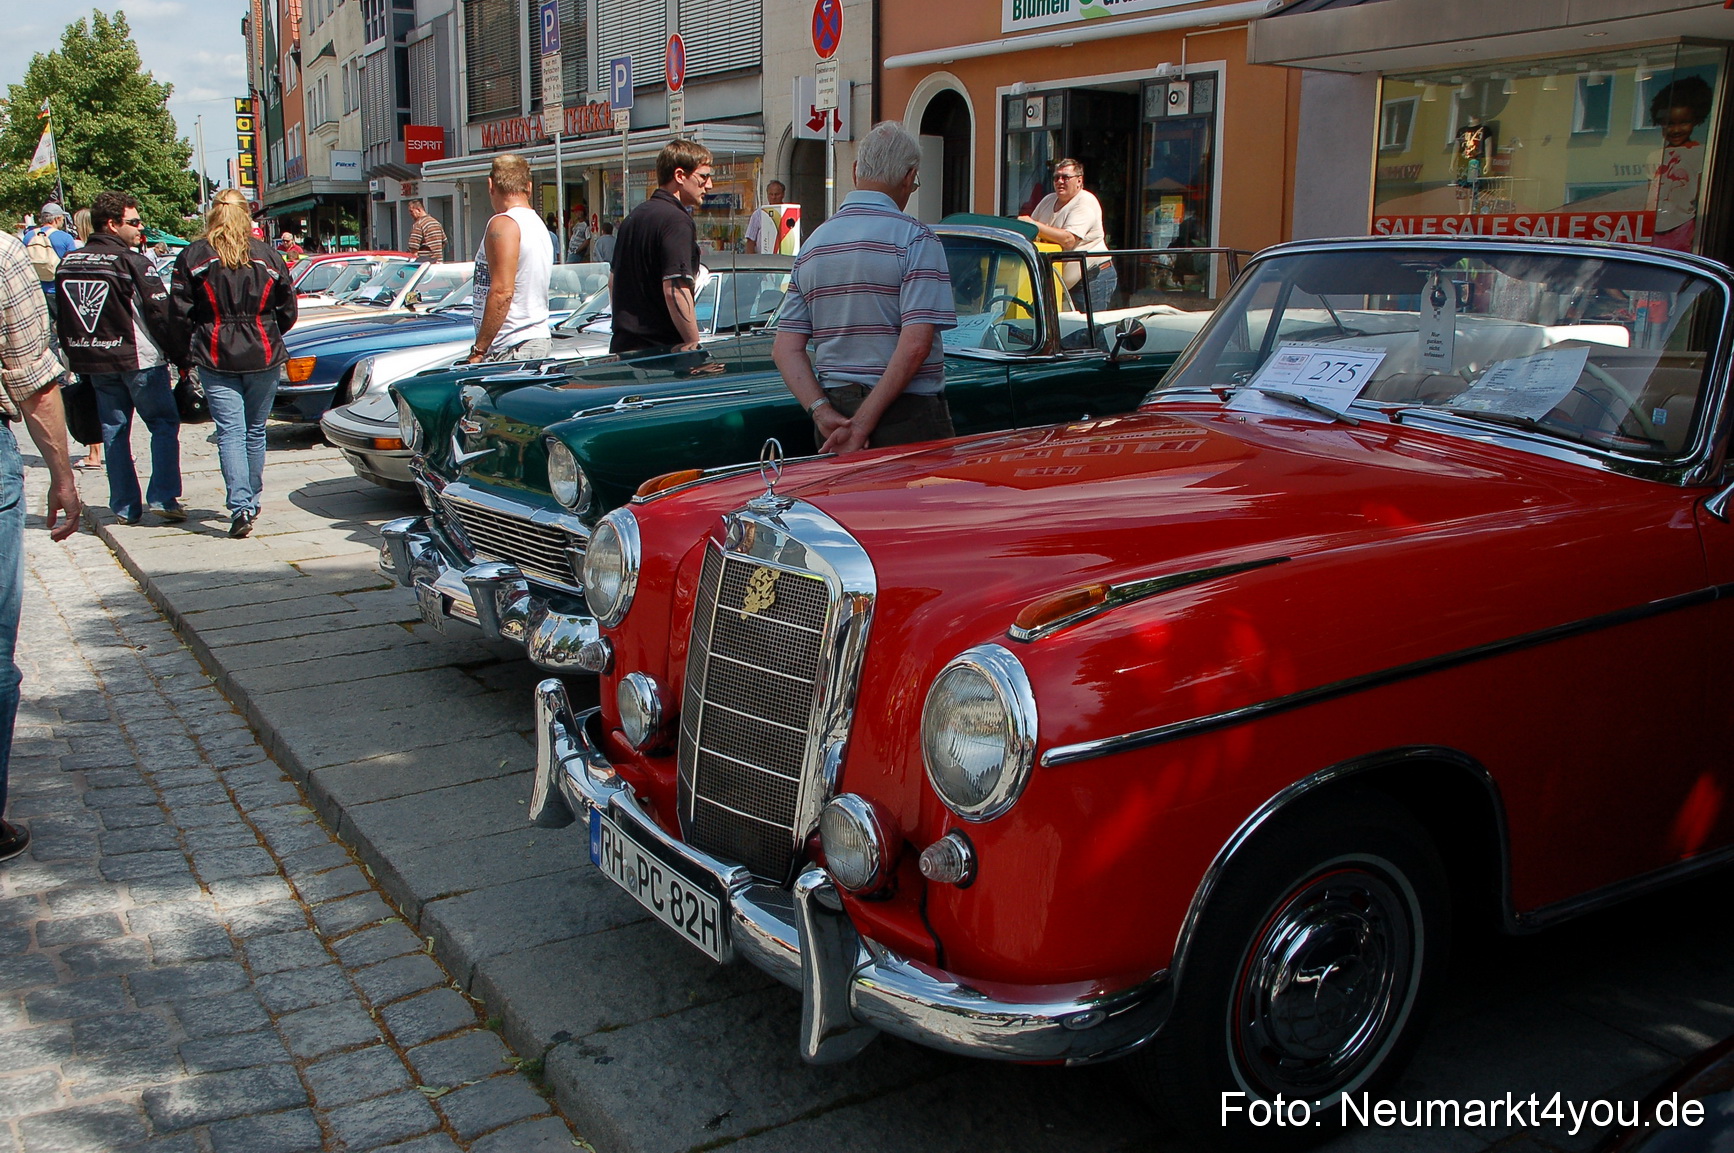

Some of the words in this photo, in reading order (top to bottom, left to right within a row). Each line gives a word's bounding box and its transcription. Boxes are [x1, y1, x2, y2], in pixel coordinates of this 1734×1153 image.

[544, 9, 554, 48] P
[1011, 0, 1071, 21] Blumen
[615, 63, 627, 103] P
[236, 99, 255, 186] HOTEL
[480, 101, 615, 148] MARIEN-ATHEKE
[407, 139, 443, 151] ESPRIT
[1514, 216, 1588, 240] SALE
[1308, 360, 1364, 384] 275
[600, 823, 625, 882] RH
[636, 852, 666, 913] PC
